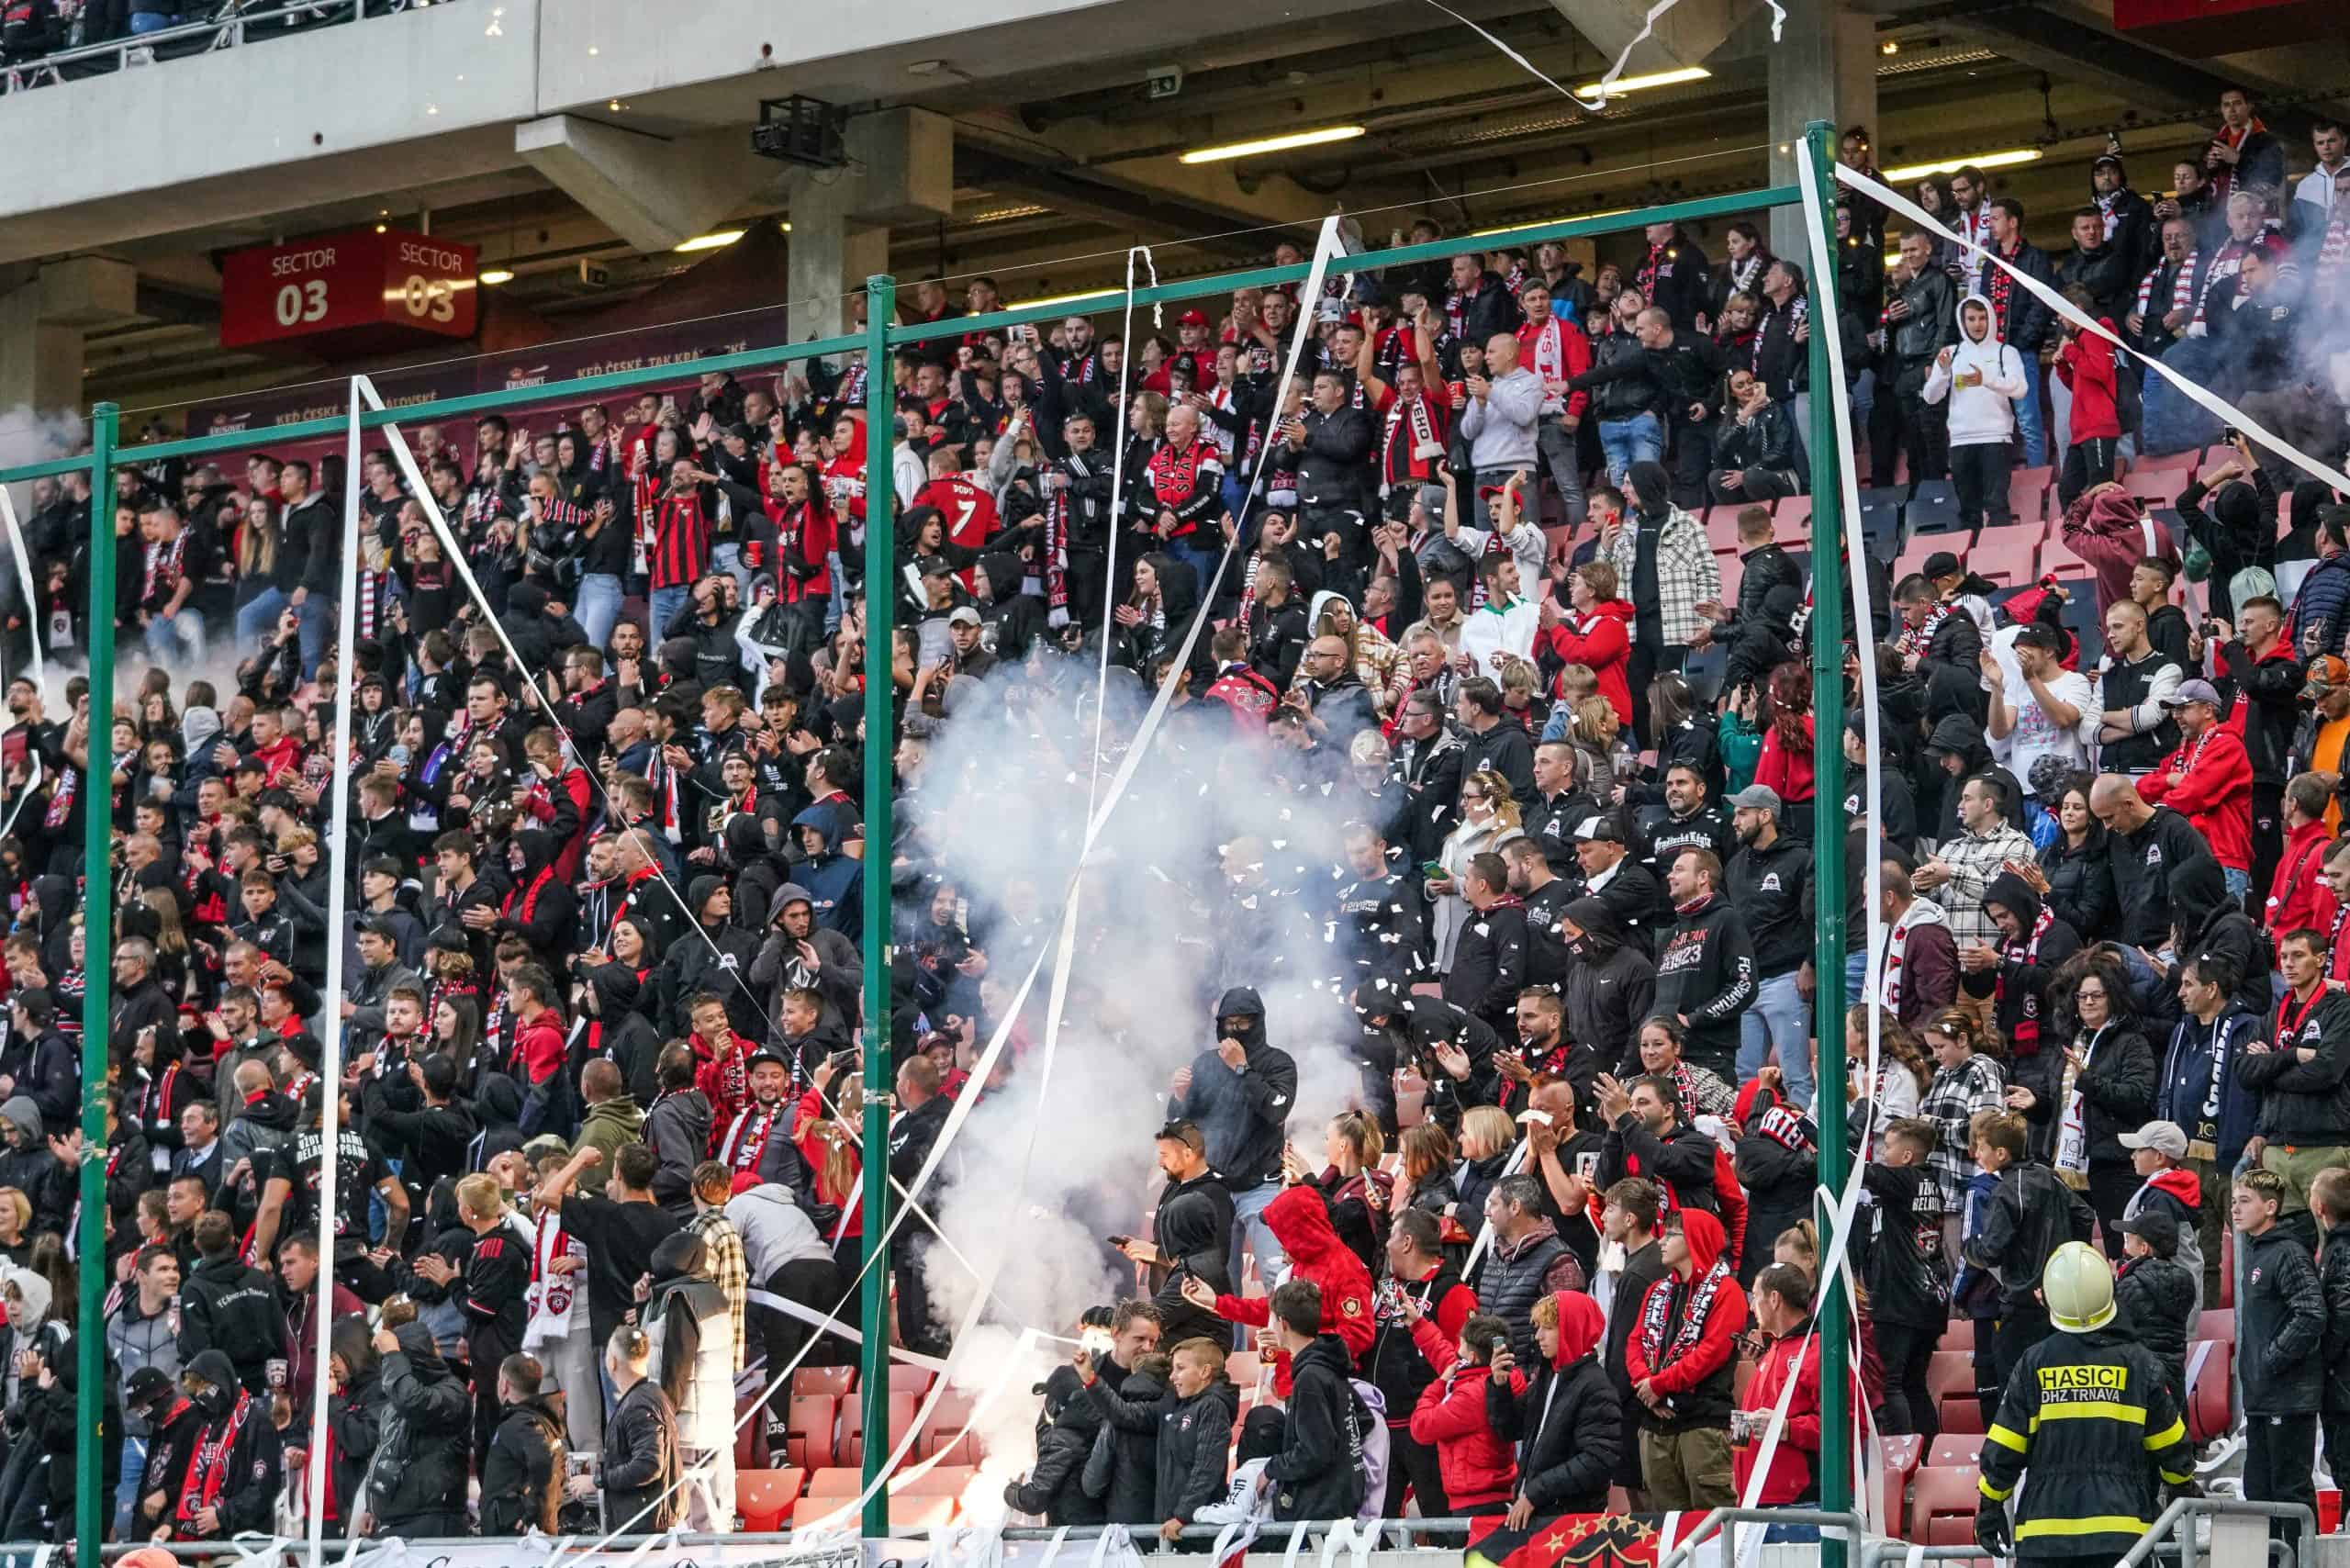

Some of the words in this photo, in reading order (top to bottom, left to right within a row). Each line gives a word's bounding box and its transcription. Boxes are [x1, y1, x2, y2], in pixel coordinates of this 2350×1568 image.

[272, 248, 336, 276] SECTOR
[400, 242, 463, 273] SECTOR
[277, 279, 329, 326] 03
[406, 274, 455, 322] 03
[952, 499, 977, 536] 7
[1738, 956, 1751, 973] FC
[1707, 980, 1751, 1018] SPARTAK
[2042, 1389, 2068, 1404] DHZ
[2070, 1387, 2121, 1403] TRNAVA
